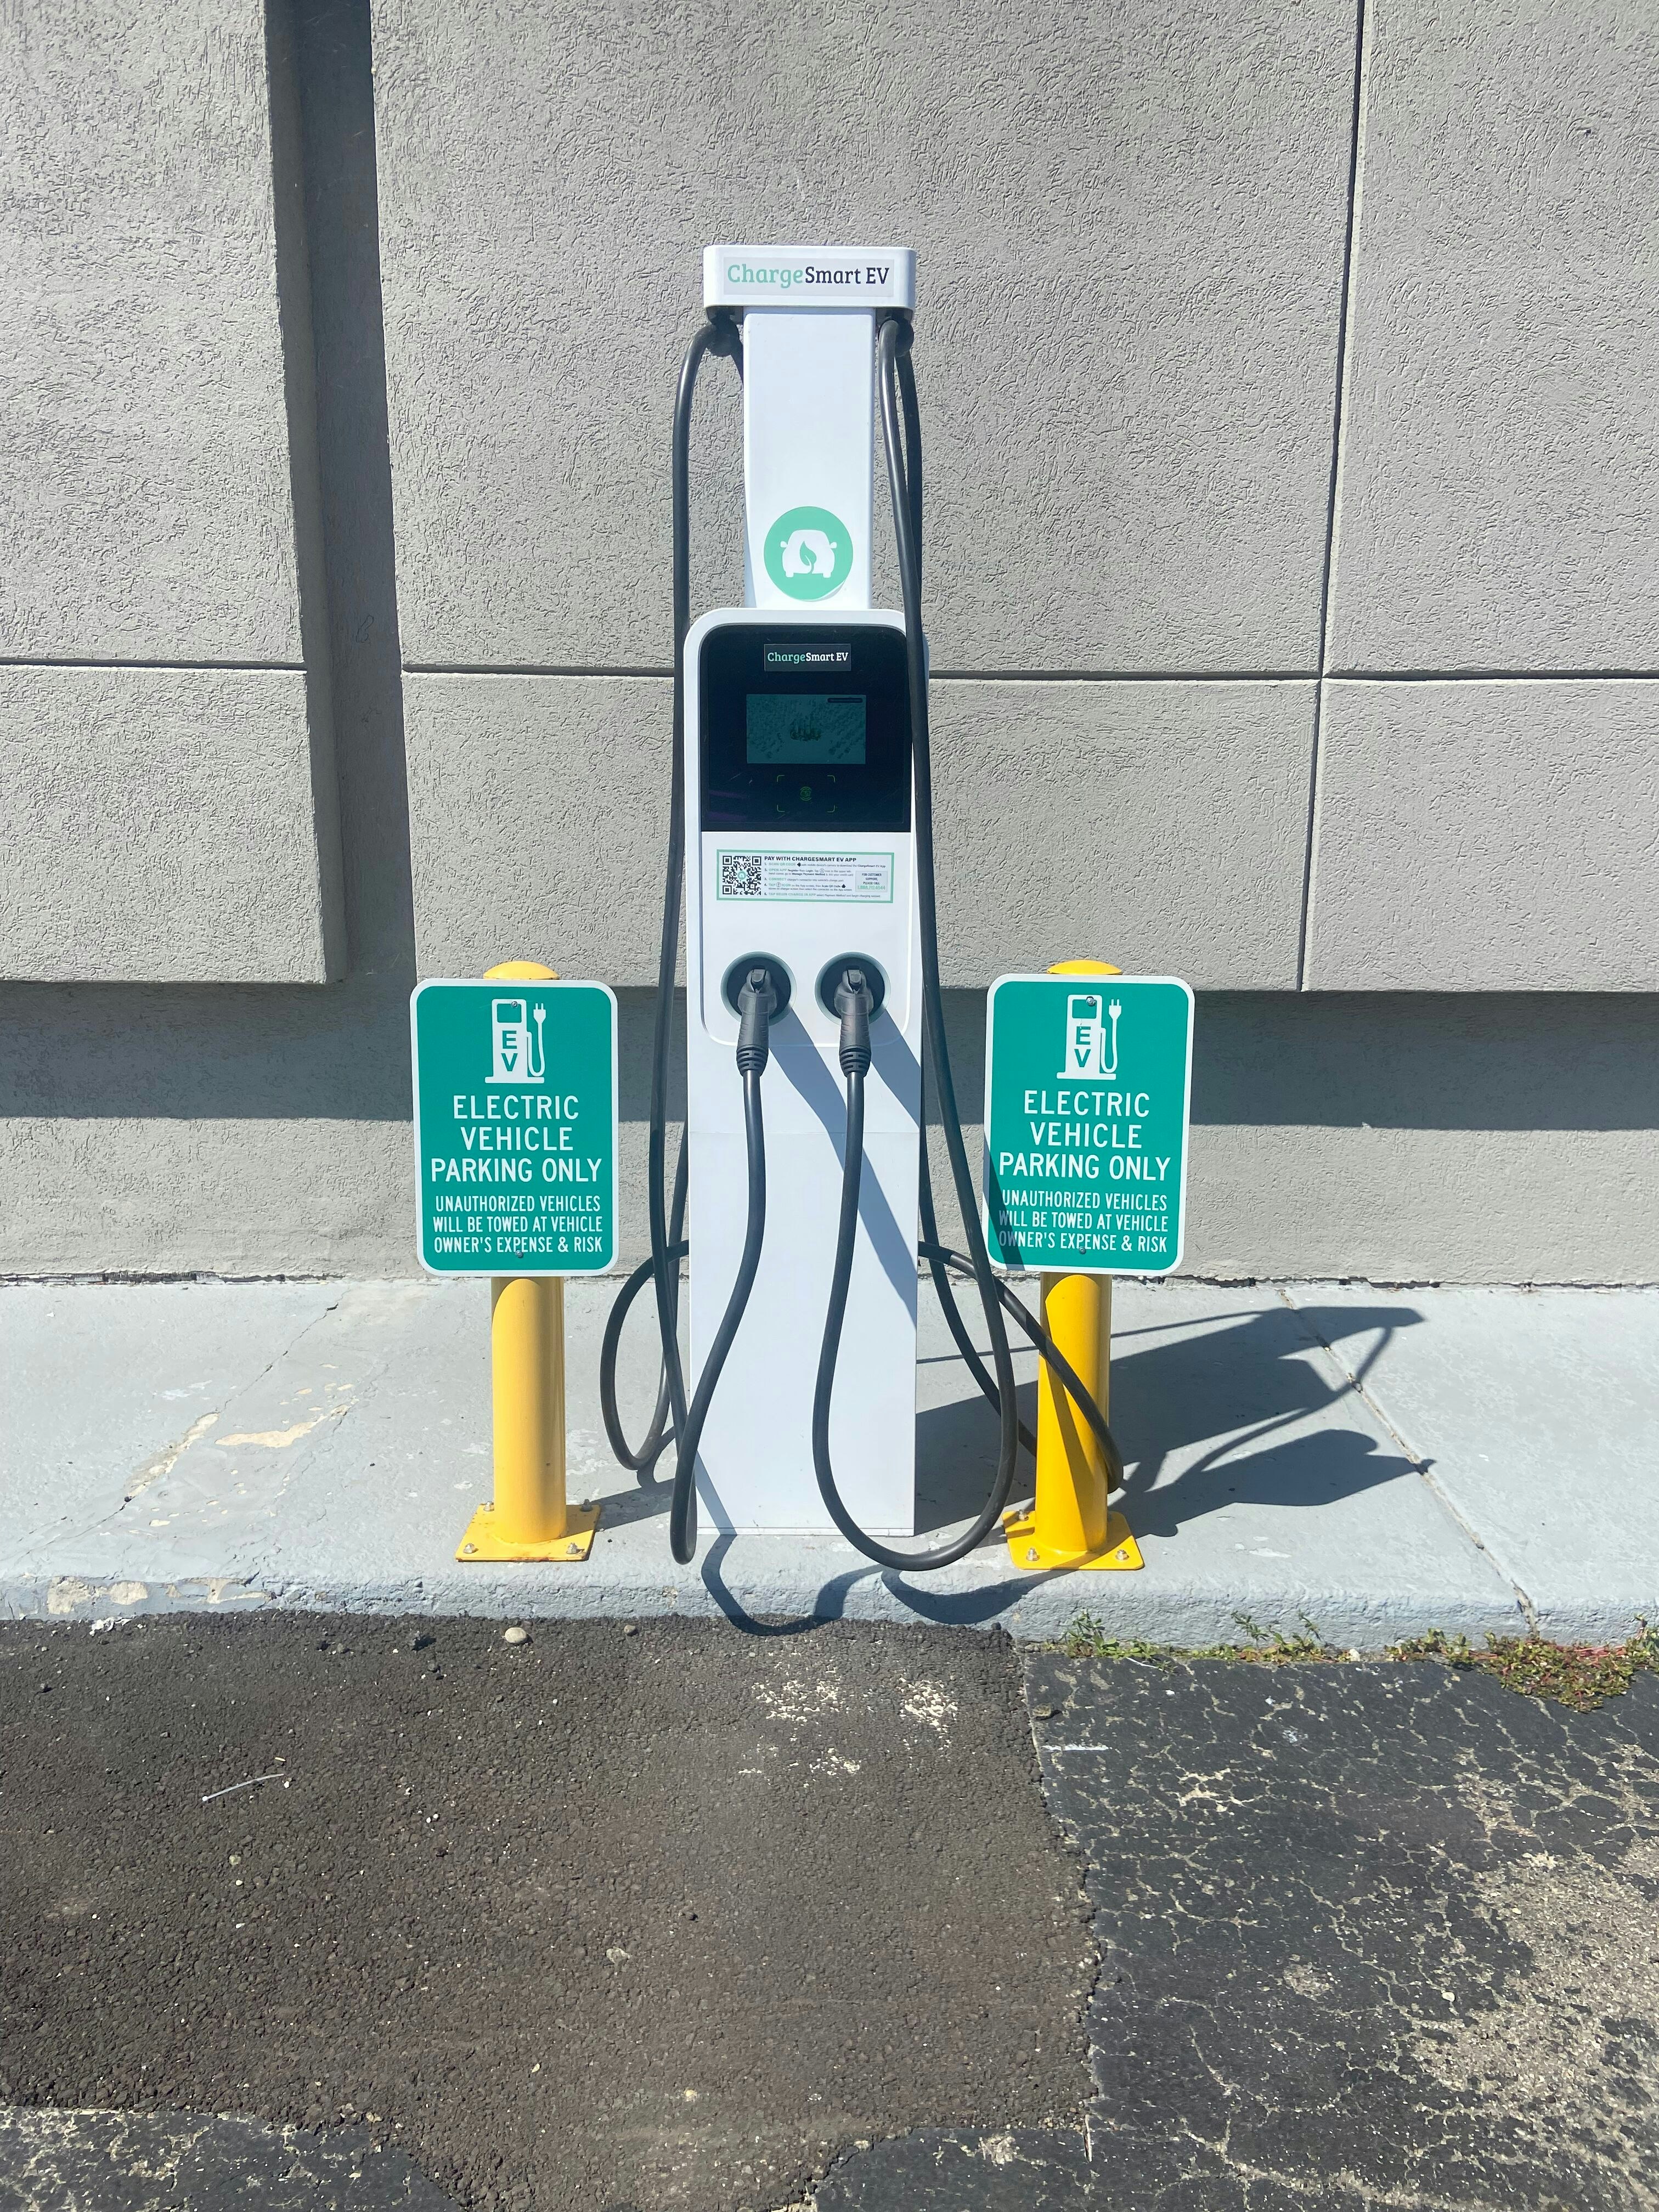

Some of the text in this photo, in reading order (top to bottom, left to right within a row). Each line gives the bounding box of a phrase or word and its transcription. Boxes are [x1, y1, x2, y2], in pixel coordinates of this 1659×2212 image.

[727, 264, 890, 289] ChargeSmart EV
[768, 652, 849, 664] ChargeSmart EV
[454, 1095, 578, 1119] ELECTRIC
[1025, 1090, 1149, 1117] ELECTRIC
[461, 1127, 573, 1150] VEHICLE
[1030, 1122, 1141, 1148] VEHICLE
[432, 1158, 601, 1182] PARKING ONLY
[1000, 1152, 1170, 1181] PARKING ONLY
[436, 1195, 600, 1211] UNAUTHORIZED VEHICLES
[1003, 1189, 1167, 1211] UNAUTHORIZED VEHICLES
[433, 1216, 602, 1232] WILL BE TOWED AT VEHICLE
[1000, 1210, 1168, 1232] WILL BE TOWED AT VEHICLE
[435, 1237, 602, 1253] OWNER'S EXPENSE & RISK
[1000, 1231, 1166, 1252] OWNER'S EXPENSE & RISK
